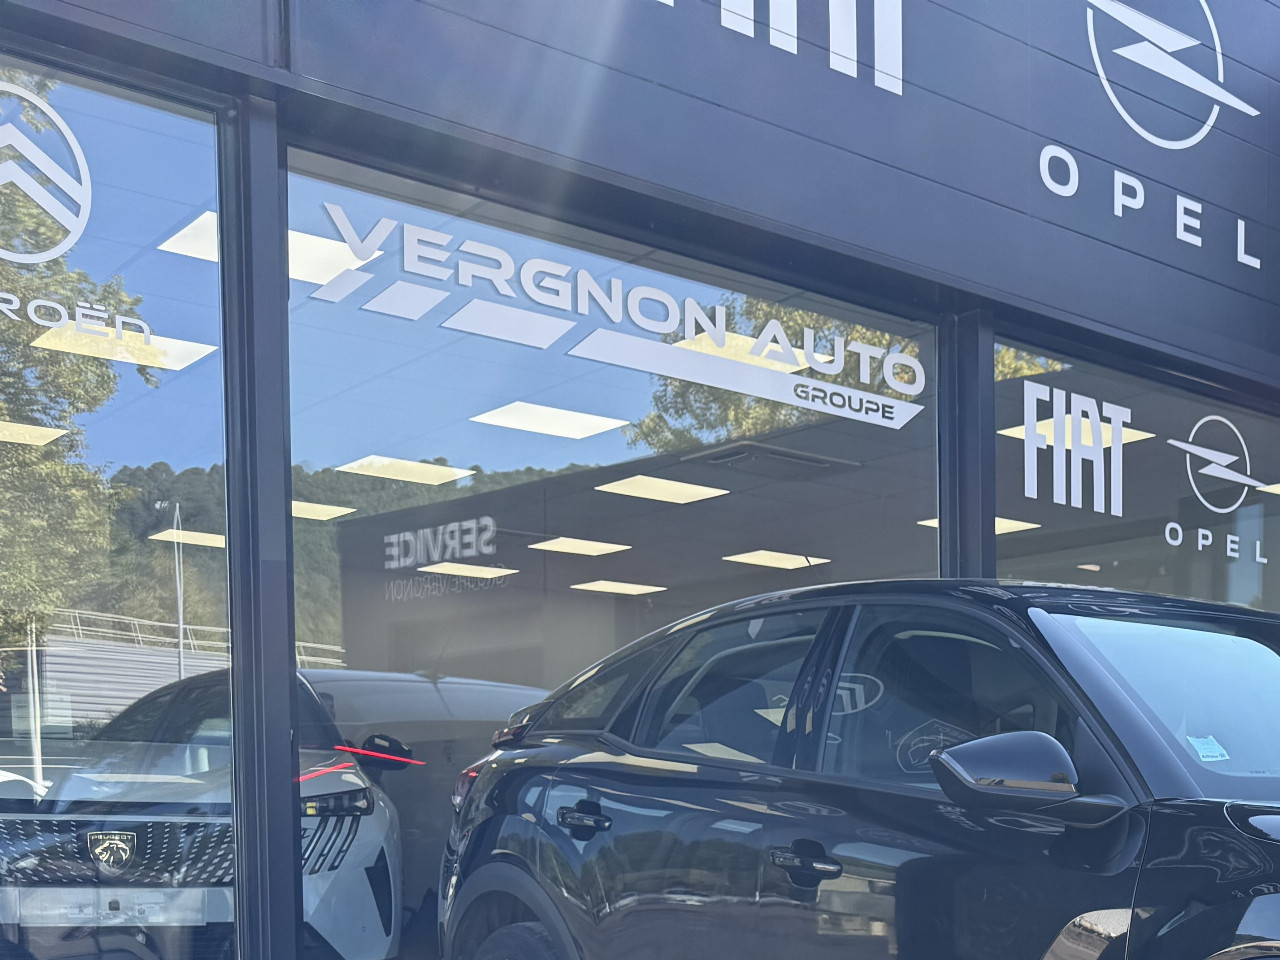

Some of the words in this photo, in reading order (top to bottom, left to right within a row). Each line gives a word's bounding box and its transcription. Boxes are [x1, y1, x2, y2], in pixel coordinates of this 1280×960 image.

[1039, 144, 1260, 269] OPEL
[324, 202, 726, 348] VERGNON
[751, 319, 926, 395] AUTO
[793, 383, 896, 421] GROUPE
[1023, 379, 1131, 517] FIAT
[1164, 522, 1268, 564] OPEL
